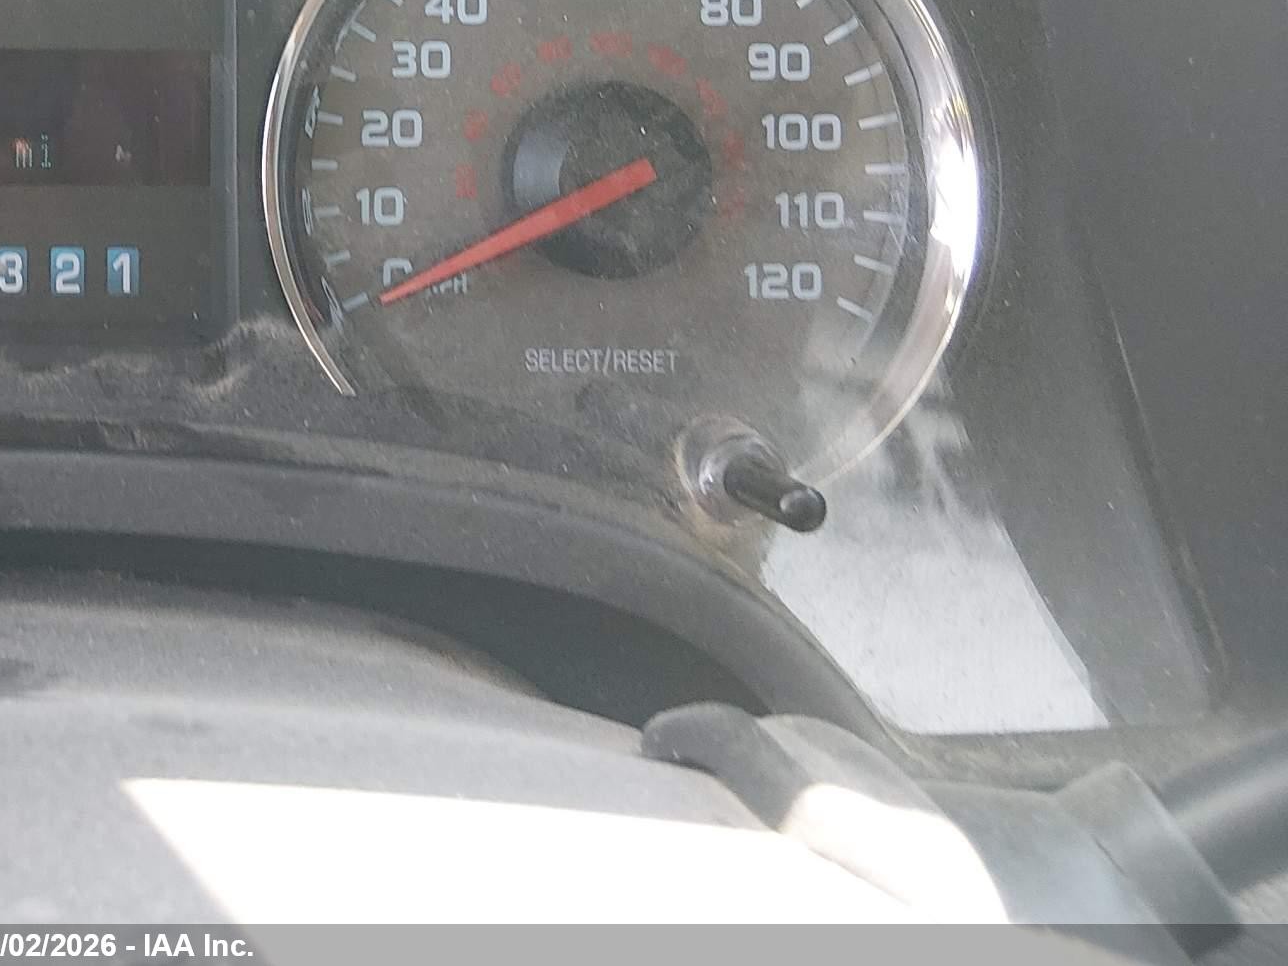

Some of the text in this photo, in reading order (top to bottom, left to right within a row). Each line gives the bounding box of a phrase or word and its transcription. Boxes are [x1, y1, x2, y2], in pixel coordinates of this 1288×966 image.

[392, 41, 451, 79] 30
[747, 43, 811, 82] 90
[361, 109, 422, 147] 20
[762, 113, 842, 152] 100
[15, 133, 52, 169] mi
[356, 188, 406, 226] 10
[775, 191, 844, 229] 110
[55, 252, 82, 294] 2
[113, 252, 132, 294] 1
[744, 262, 822, 300] 120
[524, 347, 680, 375] SELECT/RESET
